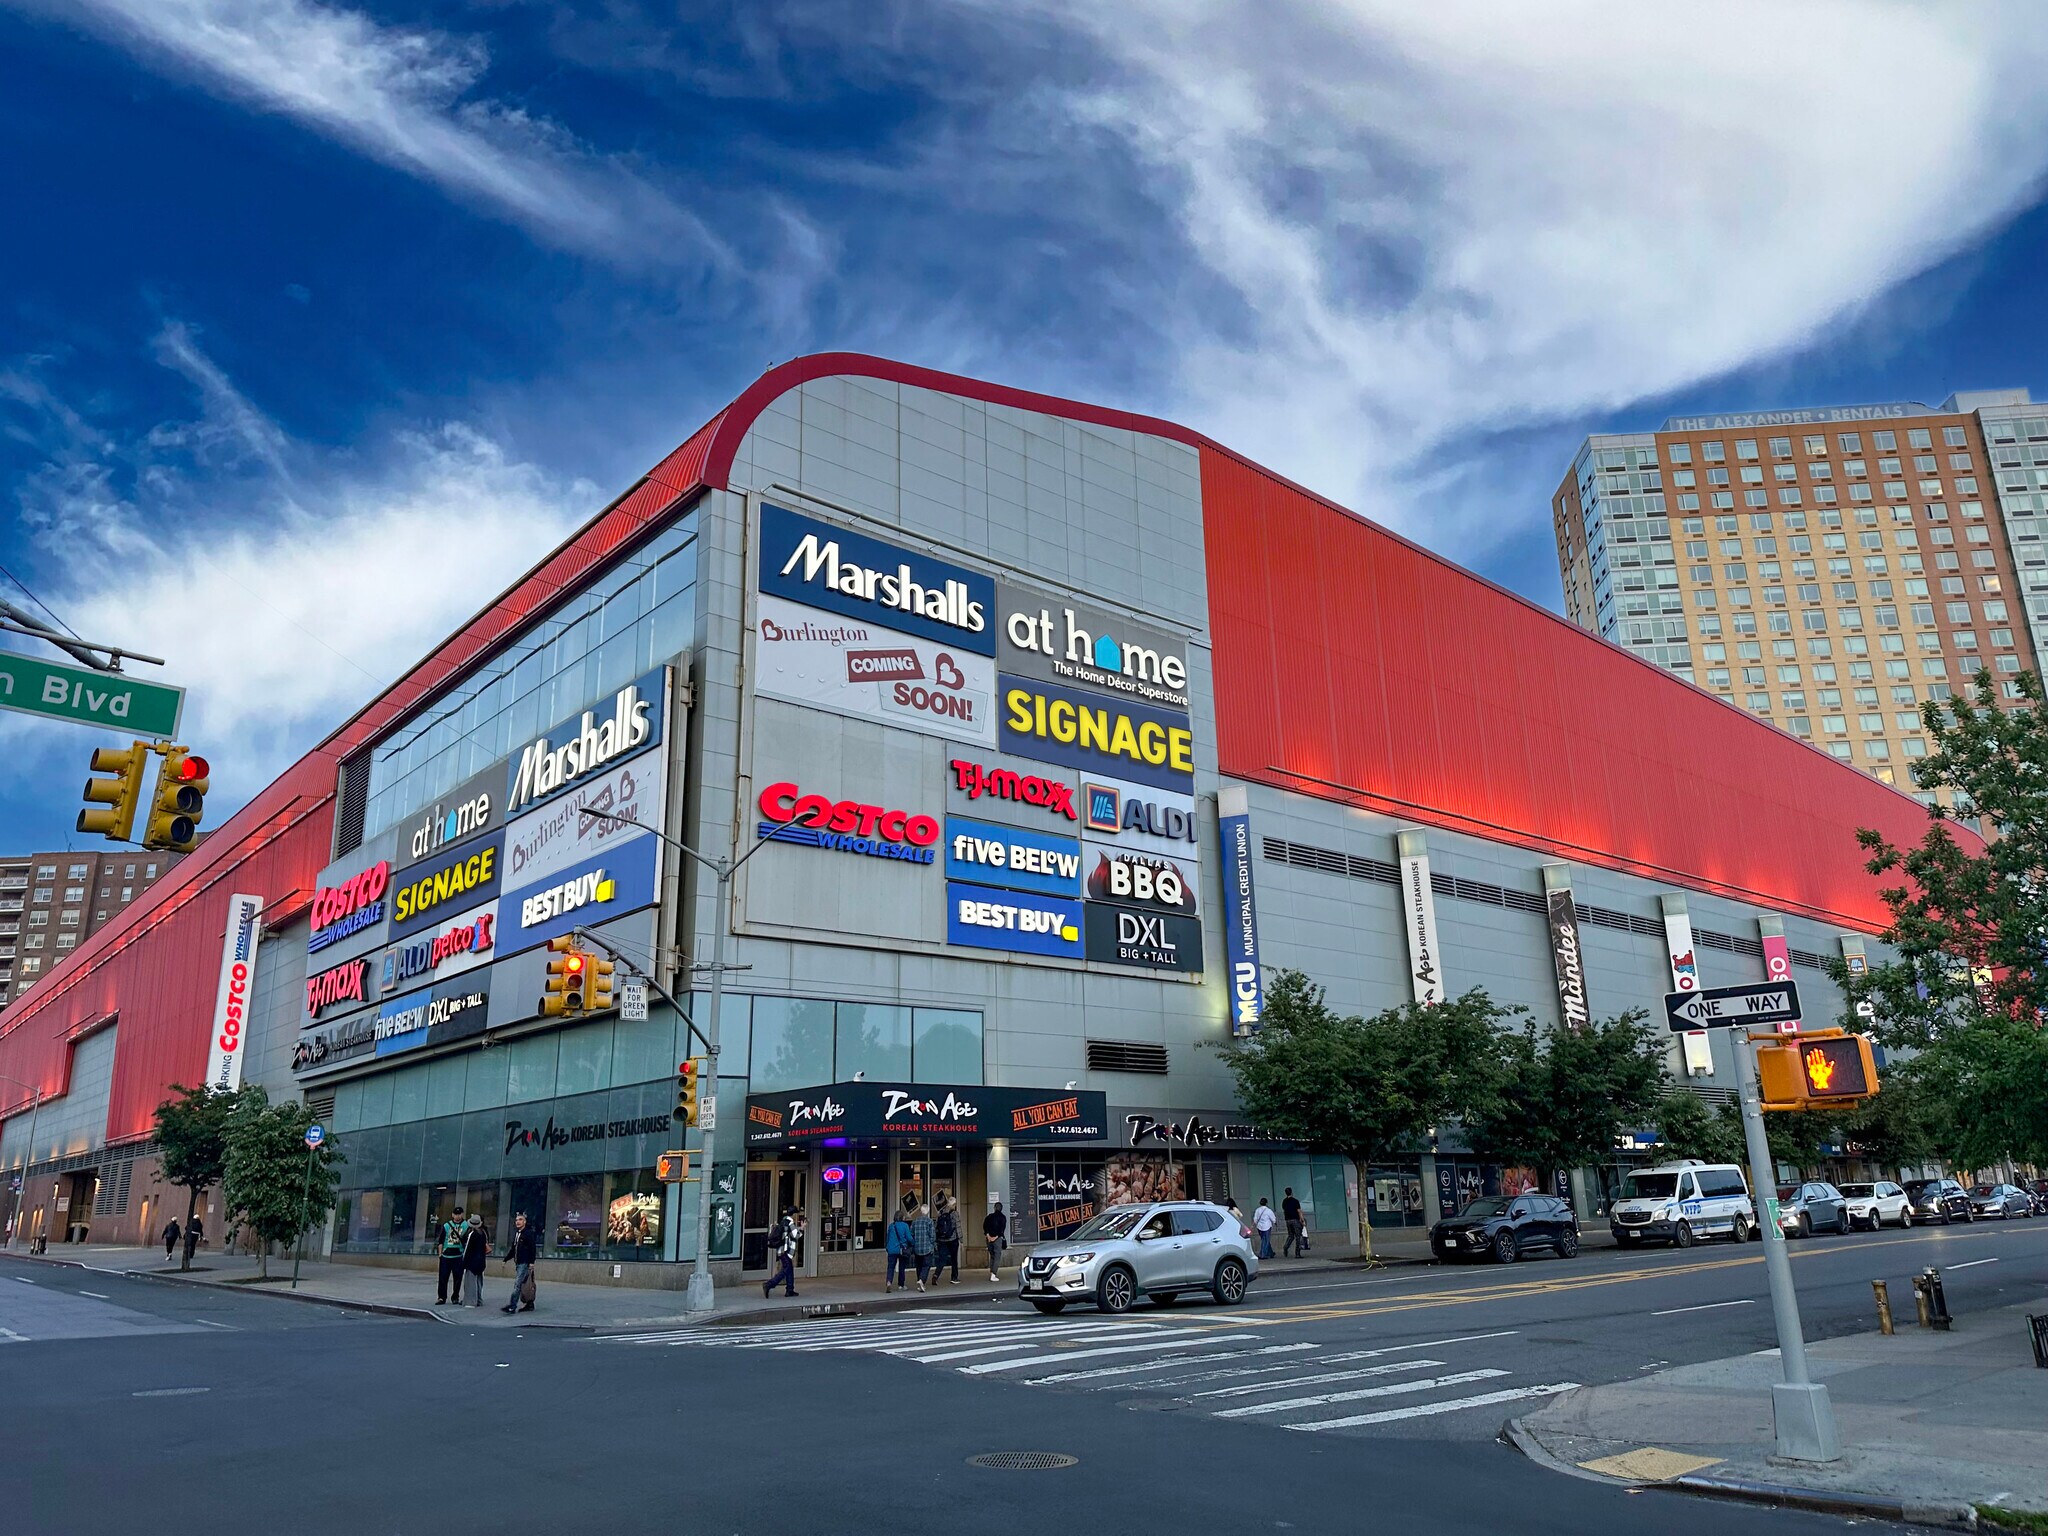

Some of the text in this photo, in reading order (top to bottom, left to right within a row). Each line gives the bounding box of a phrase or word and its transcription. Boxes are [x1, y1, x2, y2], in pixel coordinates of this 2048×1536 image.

[1676, 404, 1903, 431] THE ALEXANDER RENTALS
[779, 533, 985, 632] Marshalls
[761, 618, 869, 647] Burlington
[1007, 608, 1054, 656] at
[850, 655, 915, 674] COMING
[1053, 660, 1188, 706] The Home Décor Superstore
[41, 674, 132, 717] Blvd
[893, 682, 973, 721] SOON!
[508, 685, 650, 811] Marshalls
[1007, 688, 1194, 773] SIGNAGE
[512, 789, 588, 876] Burlington
[759, 781, 940, 846] COSTCO
[1123, 798, 1198, 843] ALDI
[411, 816, 431, 859] at
[816, 830, 935, 865] WHOLESALE
[1124, 853, 1170, 869] DALLAS
[310, 860, 389, 932] COSTCO
[394, 846, 495, 922] SIGNAGE
[520, 868, 604, 929] BEST BUY
[1109, 860, 1184, 906] BBQ
[1411, 861, 1423, 912] STEAKHOUSE
[327, 903, 382, 944] WHOLESALE
[959, 900, 1066, 936] BEST BUY
[1118, 912, 1176, 950] DXL
[1235, 824, 1259, 1023] MCU MUNICIPAL CREDIT UNION
[1417, 914, 1427, 947] KOREAN
[397, 937, 434, 980] ALDI
[432, 925, 474, 969] petco
[1120, 947, 1139, 959] BIG
[1151, 951, 1177, 964] TALL
[219, 901, 250, 1052] COSTCO WHOLESALE
[428, 997, 451, 1026] DXL
[450, 999, 461, 1014] BIG
[467, 992, 483, 1008] TALL
[1687, 994, 1783, 1018] ONE WAY
[220, 1055, 232, 1088] ARKING
[789, 1096, 845, 1126] IRON AGE
[882, 1090, 978, 1120] IRON AGE
[1013, 1100, 1078, 1129] ALL YOU CAN EAT
[541, 1116, 570, 1150] AGE
[570, 1123, 605, 1143] KOREAN
[607, 1114, 670, 1139] STEAKHOUSE
[788, 1125, 844, 1137] KOREAN STEAKHOUSE
[882, 1123, 978, 1132] KOREAN STEAKHOUSE
[1064, 1208, 1080, 1222] CAN
[1684, 1204, 1702, 1215] NYPD
